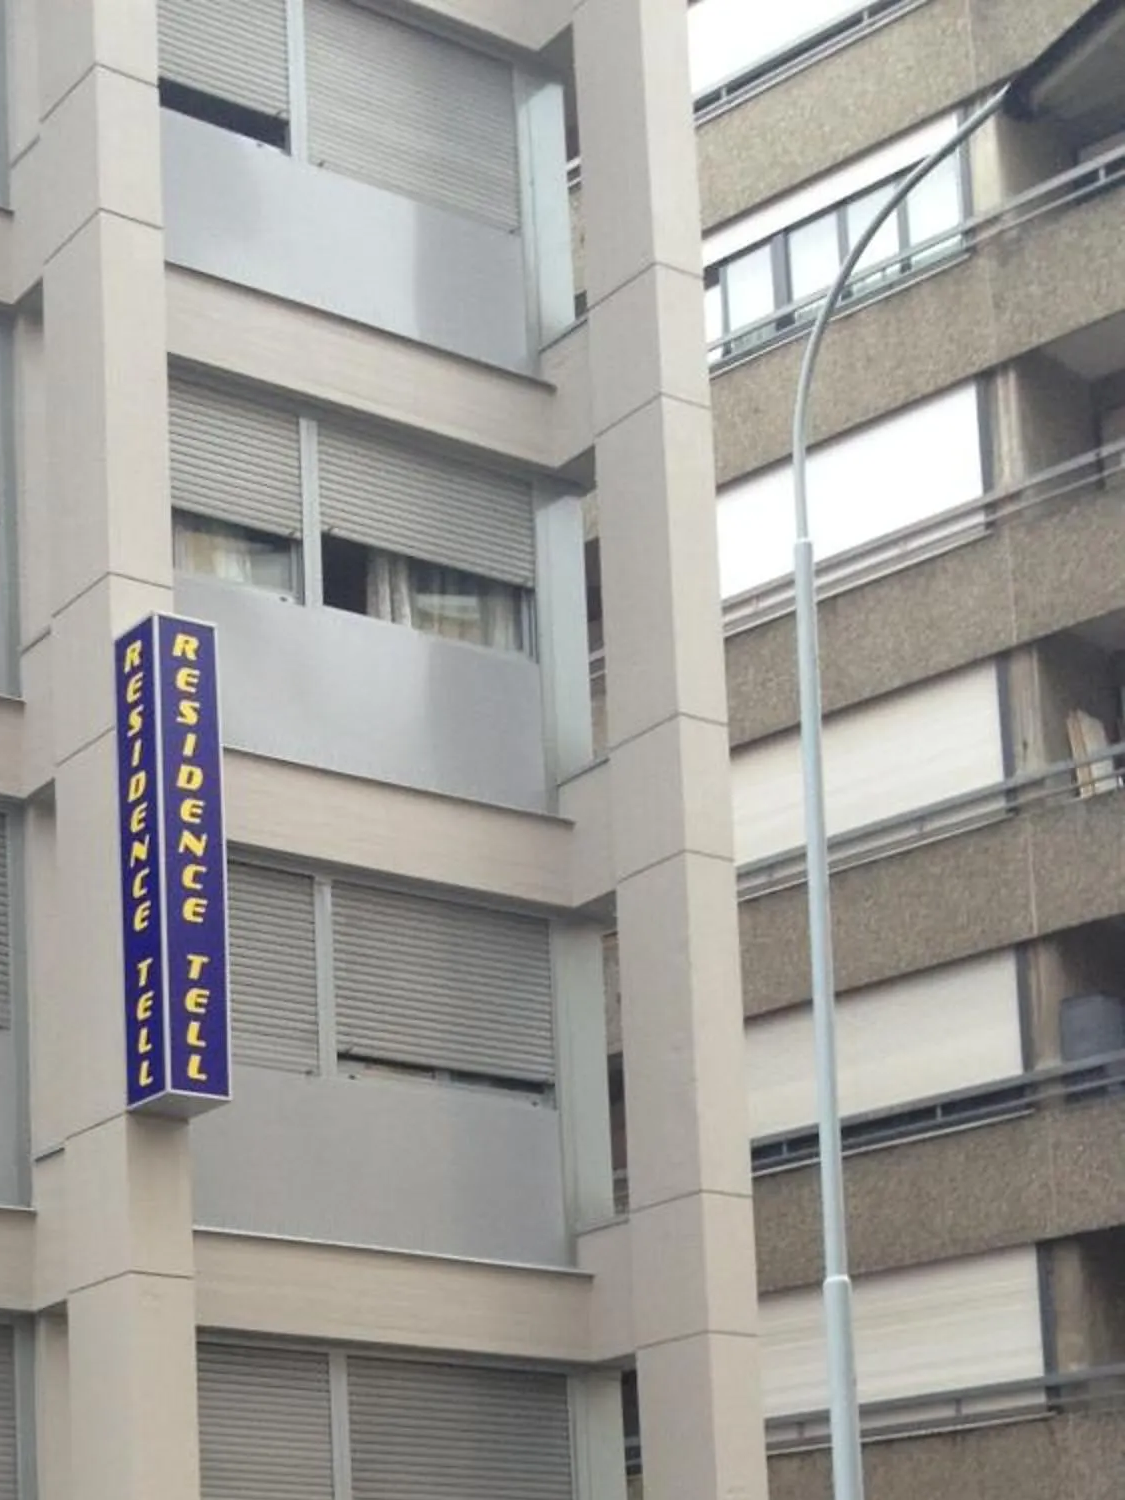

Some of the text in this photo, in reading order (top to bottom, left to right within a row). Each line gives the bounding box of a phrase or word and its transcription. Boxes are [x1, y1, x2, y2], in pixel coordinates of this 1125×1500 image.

[123, 640, 155, 1088] RESIDENCE TELL
[172, 633, 210, 1082] RESIDENCE TELL
